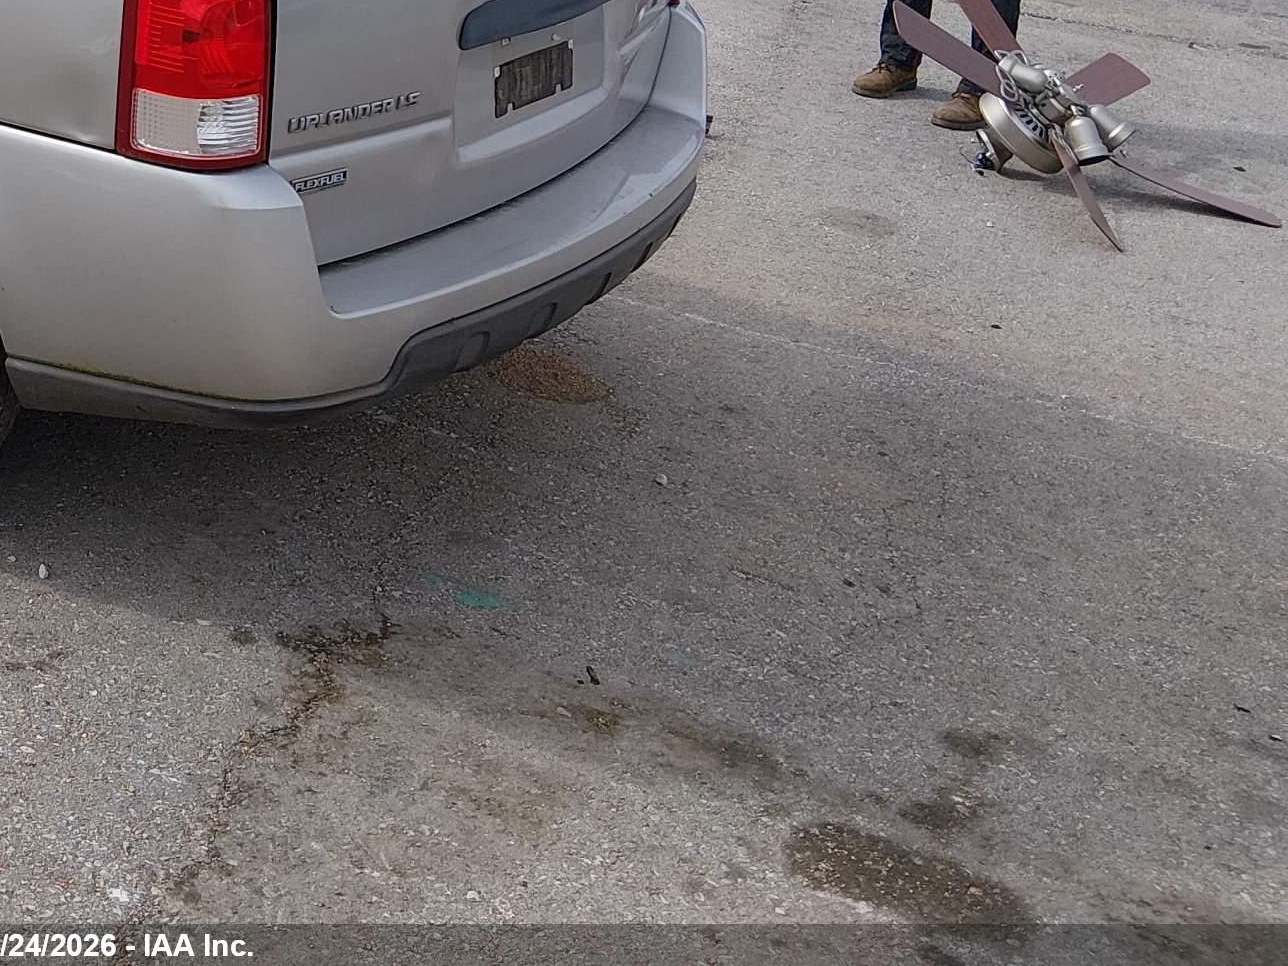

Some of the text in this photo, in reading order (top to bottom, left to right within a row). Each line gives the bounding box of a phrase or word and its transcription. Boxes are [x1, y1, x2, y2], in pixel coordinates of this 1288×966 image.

[287, 91, 421, 134] UPLANDER LS
[294, 172, 346, 192] FLEXFUEL
